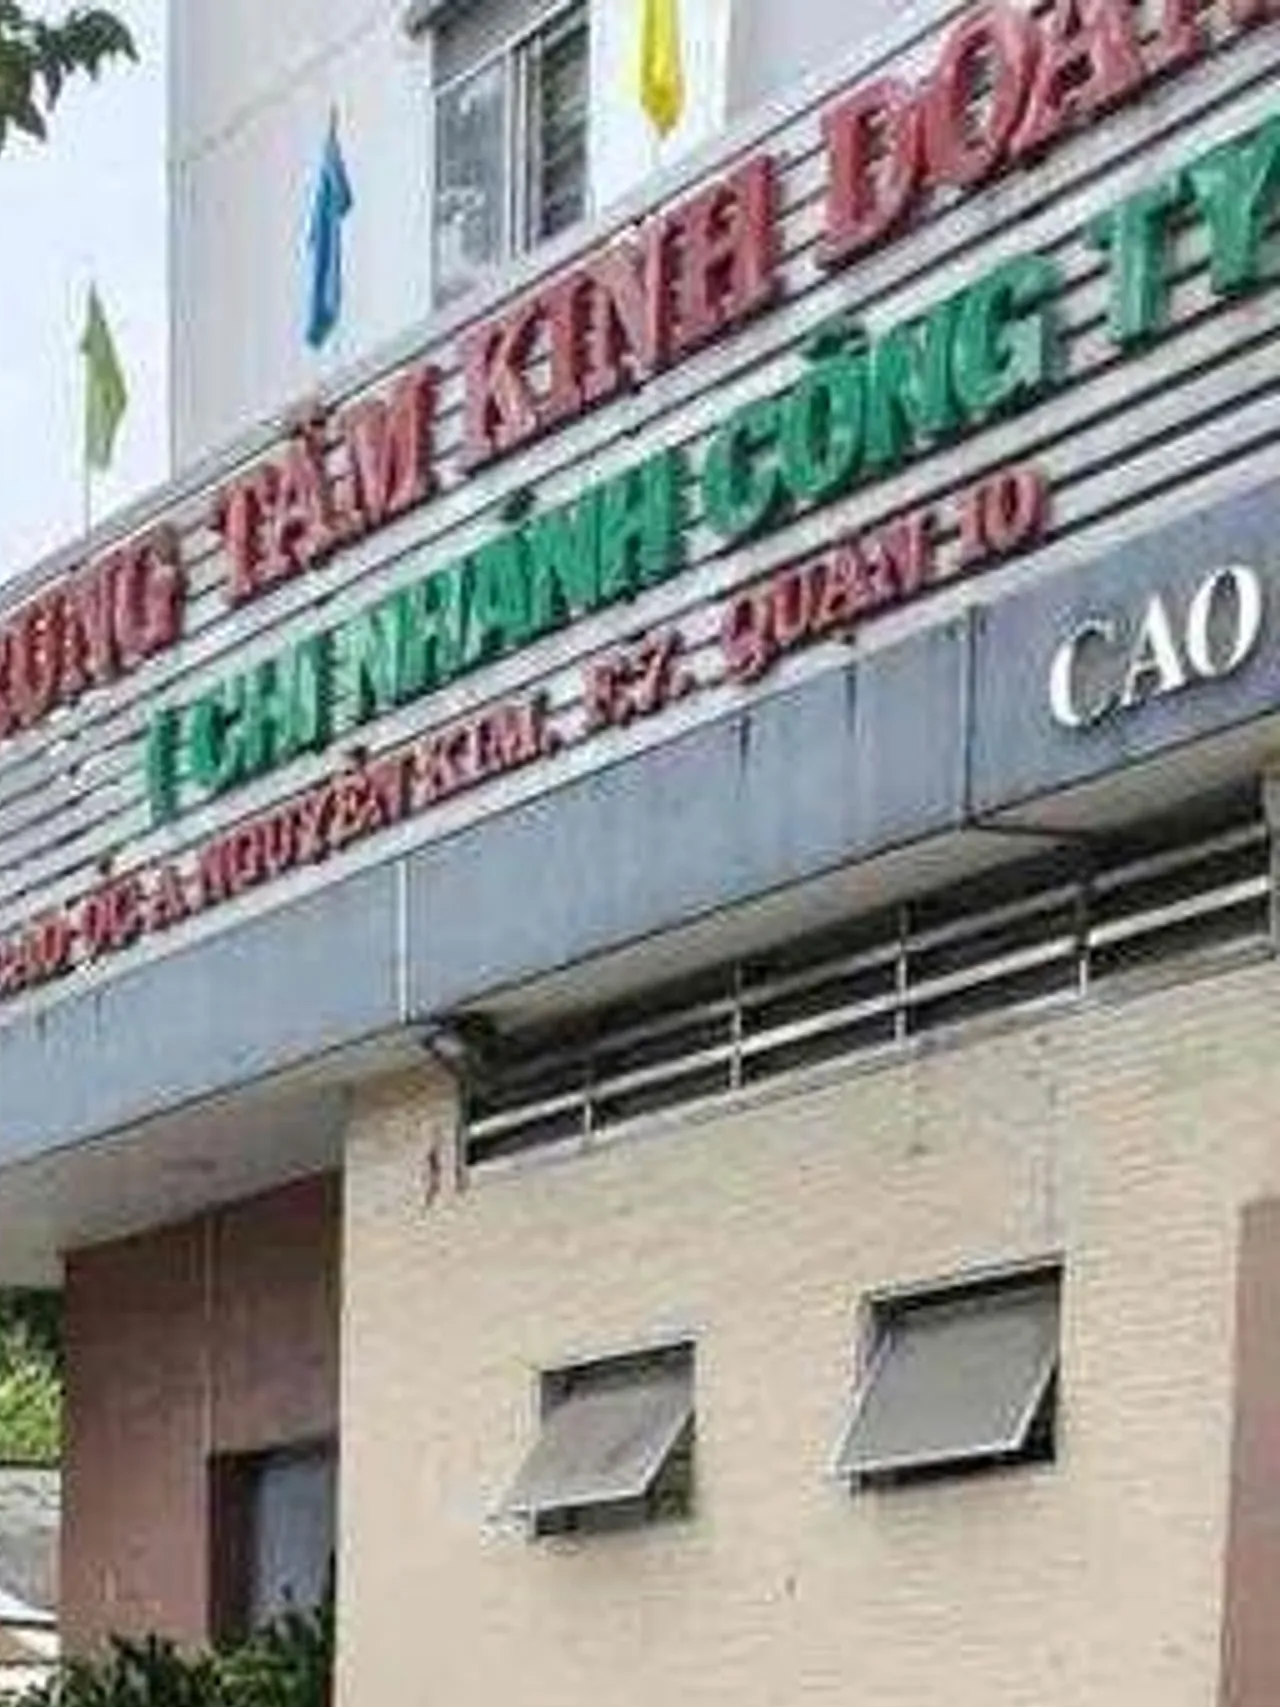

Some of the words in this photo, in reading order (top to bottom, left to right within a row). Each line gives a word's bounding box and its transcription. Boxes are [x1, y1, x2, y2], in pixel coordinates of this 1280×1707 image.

[186, 630, 336, 798] CHI
[340, 448, 684, 726] NHÁNH
[700, 252, 1058, 540] CÔNG
[1084, 114, 1280, 344] TY
[214, 362, 440, 608] TÂM
[456, 152, 782, 474] KINH
[952, 464, 1052, 562] 10
[1049, 564, 1262, 728] CAO
